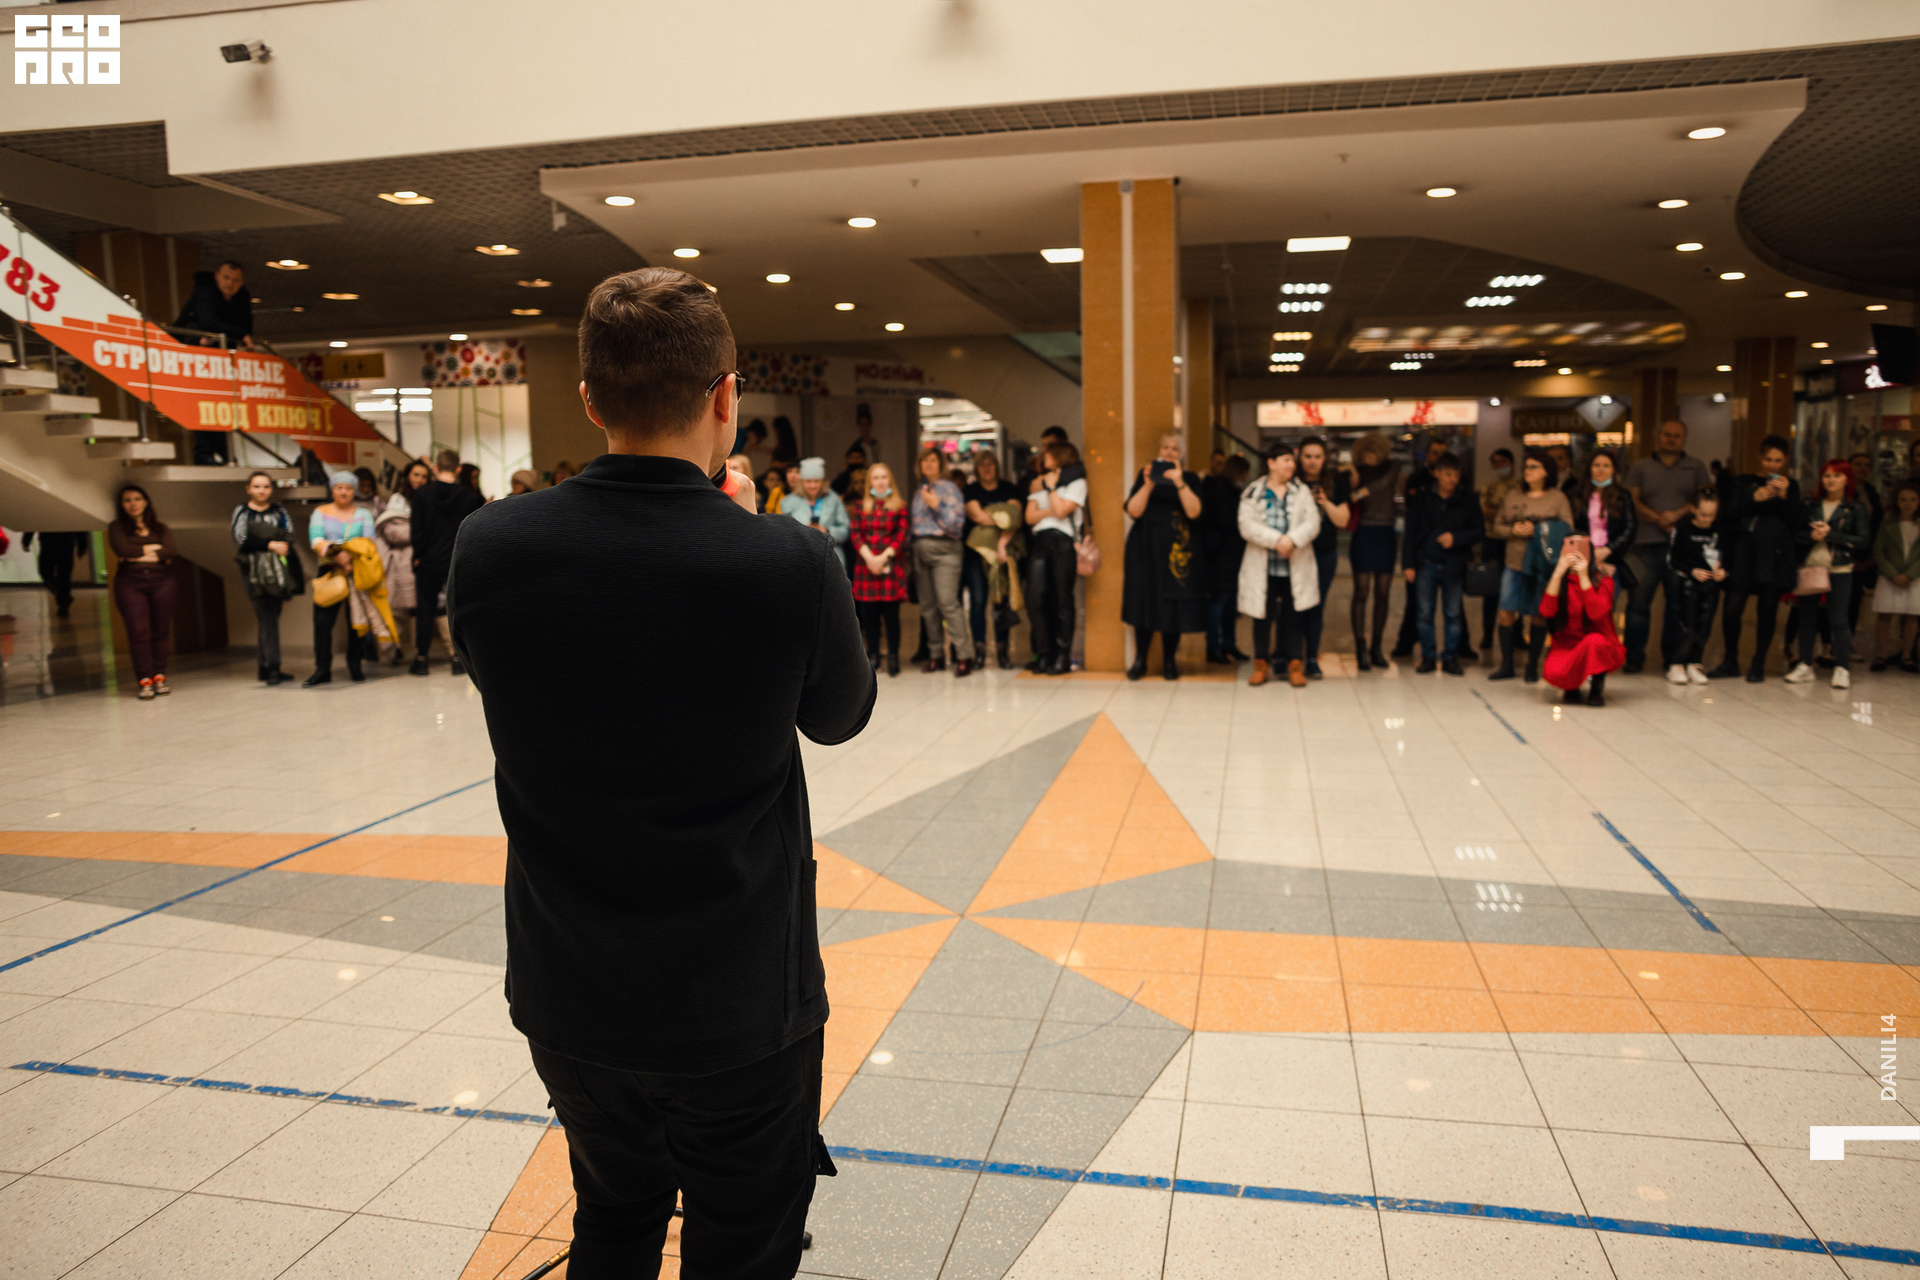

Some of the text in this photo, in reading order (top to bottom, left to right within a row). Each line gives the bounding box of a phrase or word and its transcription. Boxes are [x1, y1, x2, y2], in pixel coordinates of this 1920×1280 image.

[93, 340, 285, 383] СТРОИТЕЛЬНЫЕ
[241, 384, 286, 400] работы
[198, 401, 250, 431] ПОД
